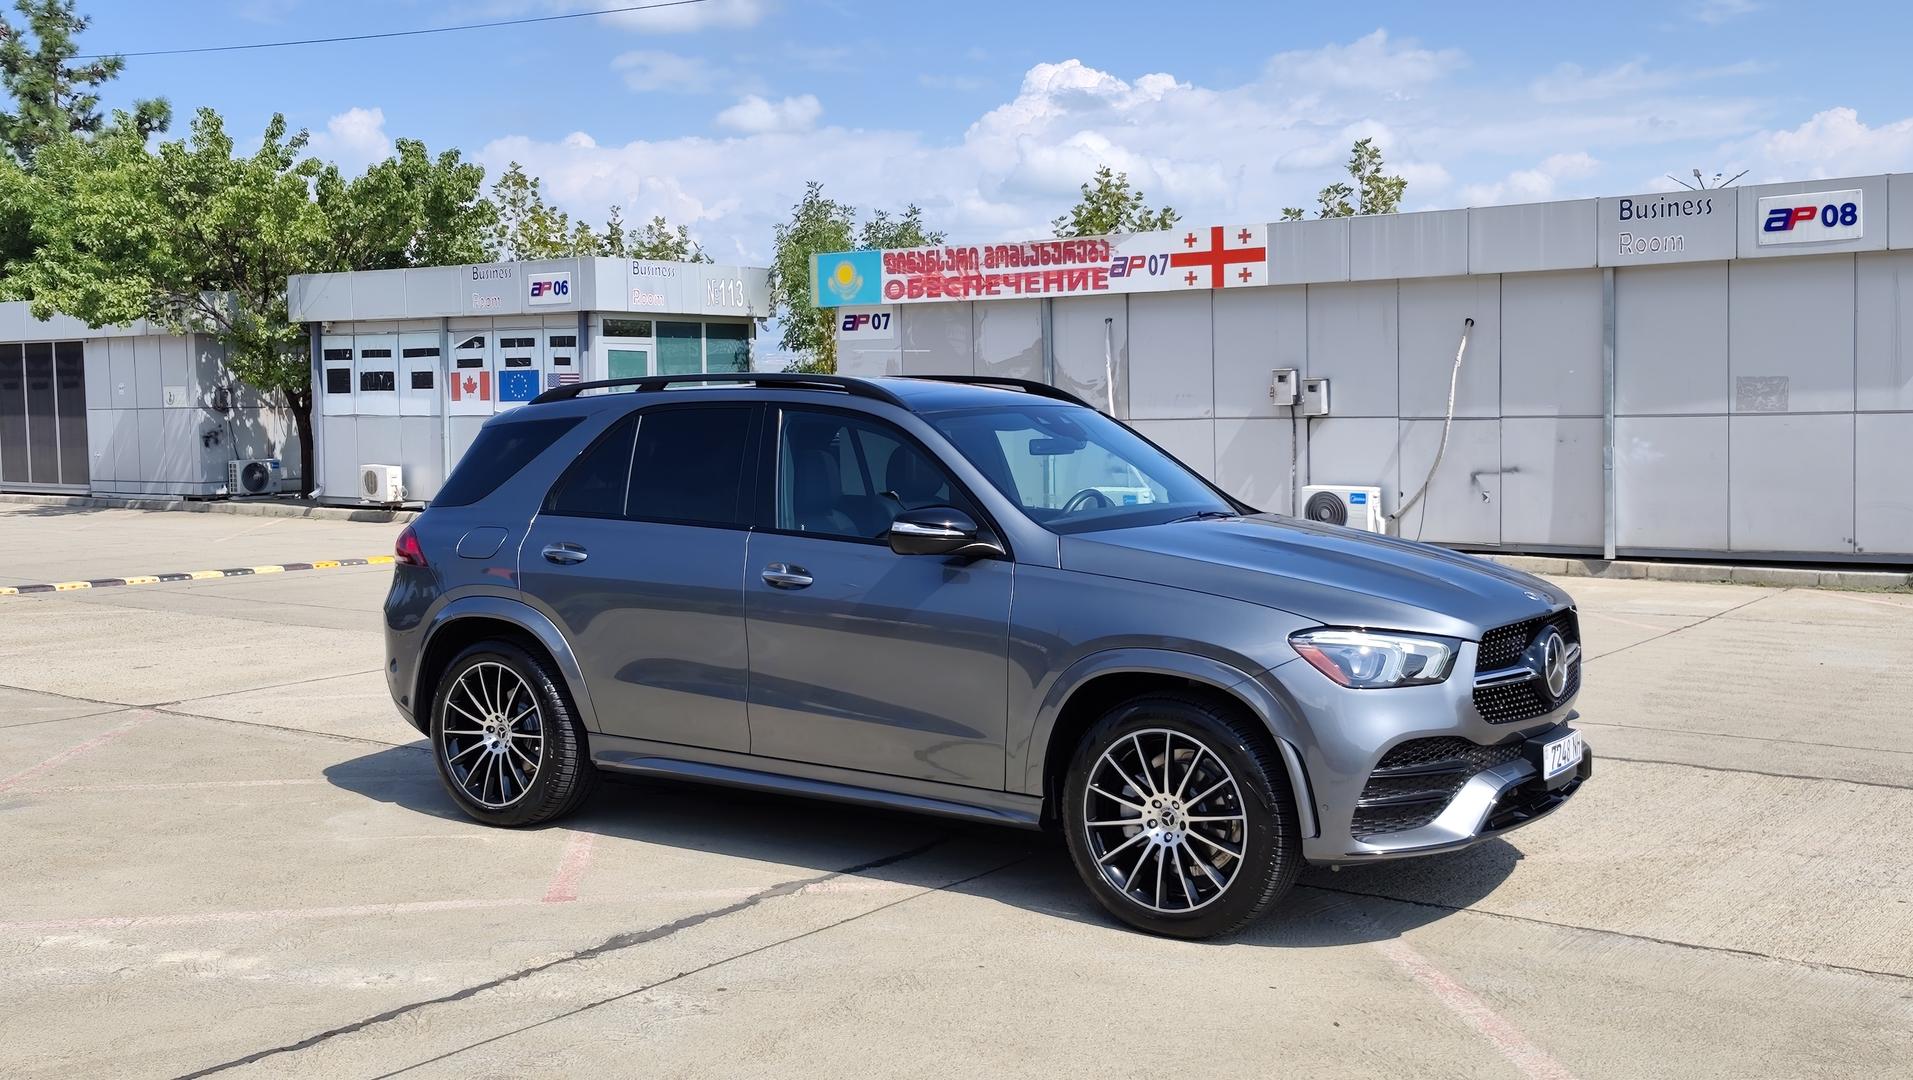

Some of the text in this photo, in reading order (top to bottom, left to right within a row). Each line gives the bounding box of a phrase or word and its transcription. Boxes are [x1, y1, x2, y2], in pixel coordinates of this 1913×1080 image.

[1619, 197, 1713, 221] Business
[1821, 202, 1858, 228] 08
[1618, 232, 1685, 256] Room
[472, 265, 512, 281] Business
[632, 260, 676, 278] Business
[1148, 253, 1169, 276] 07
[553, 280, 569, 296] 06
[884, 266, 1109, 300] ОБЕСПЕЧЕНИЕ
[632, 288, 665, 306] Room
[871, 313, 891, 330] 07
[1551, 739, 1571, 771] 7248
